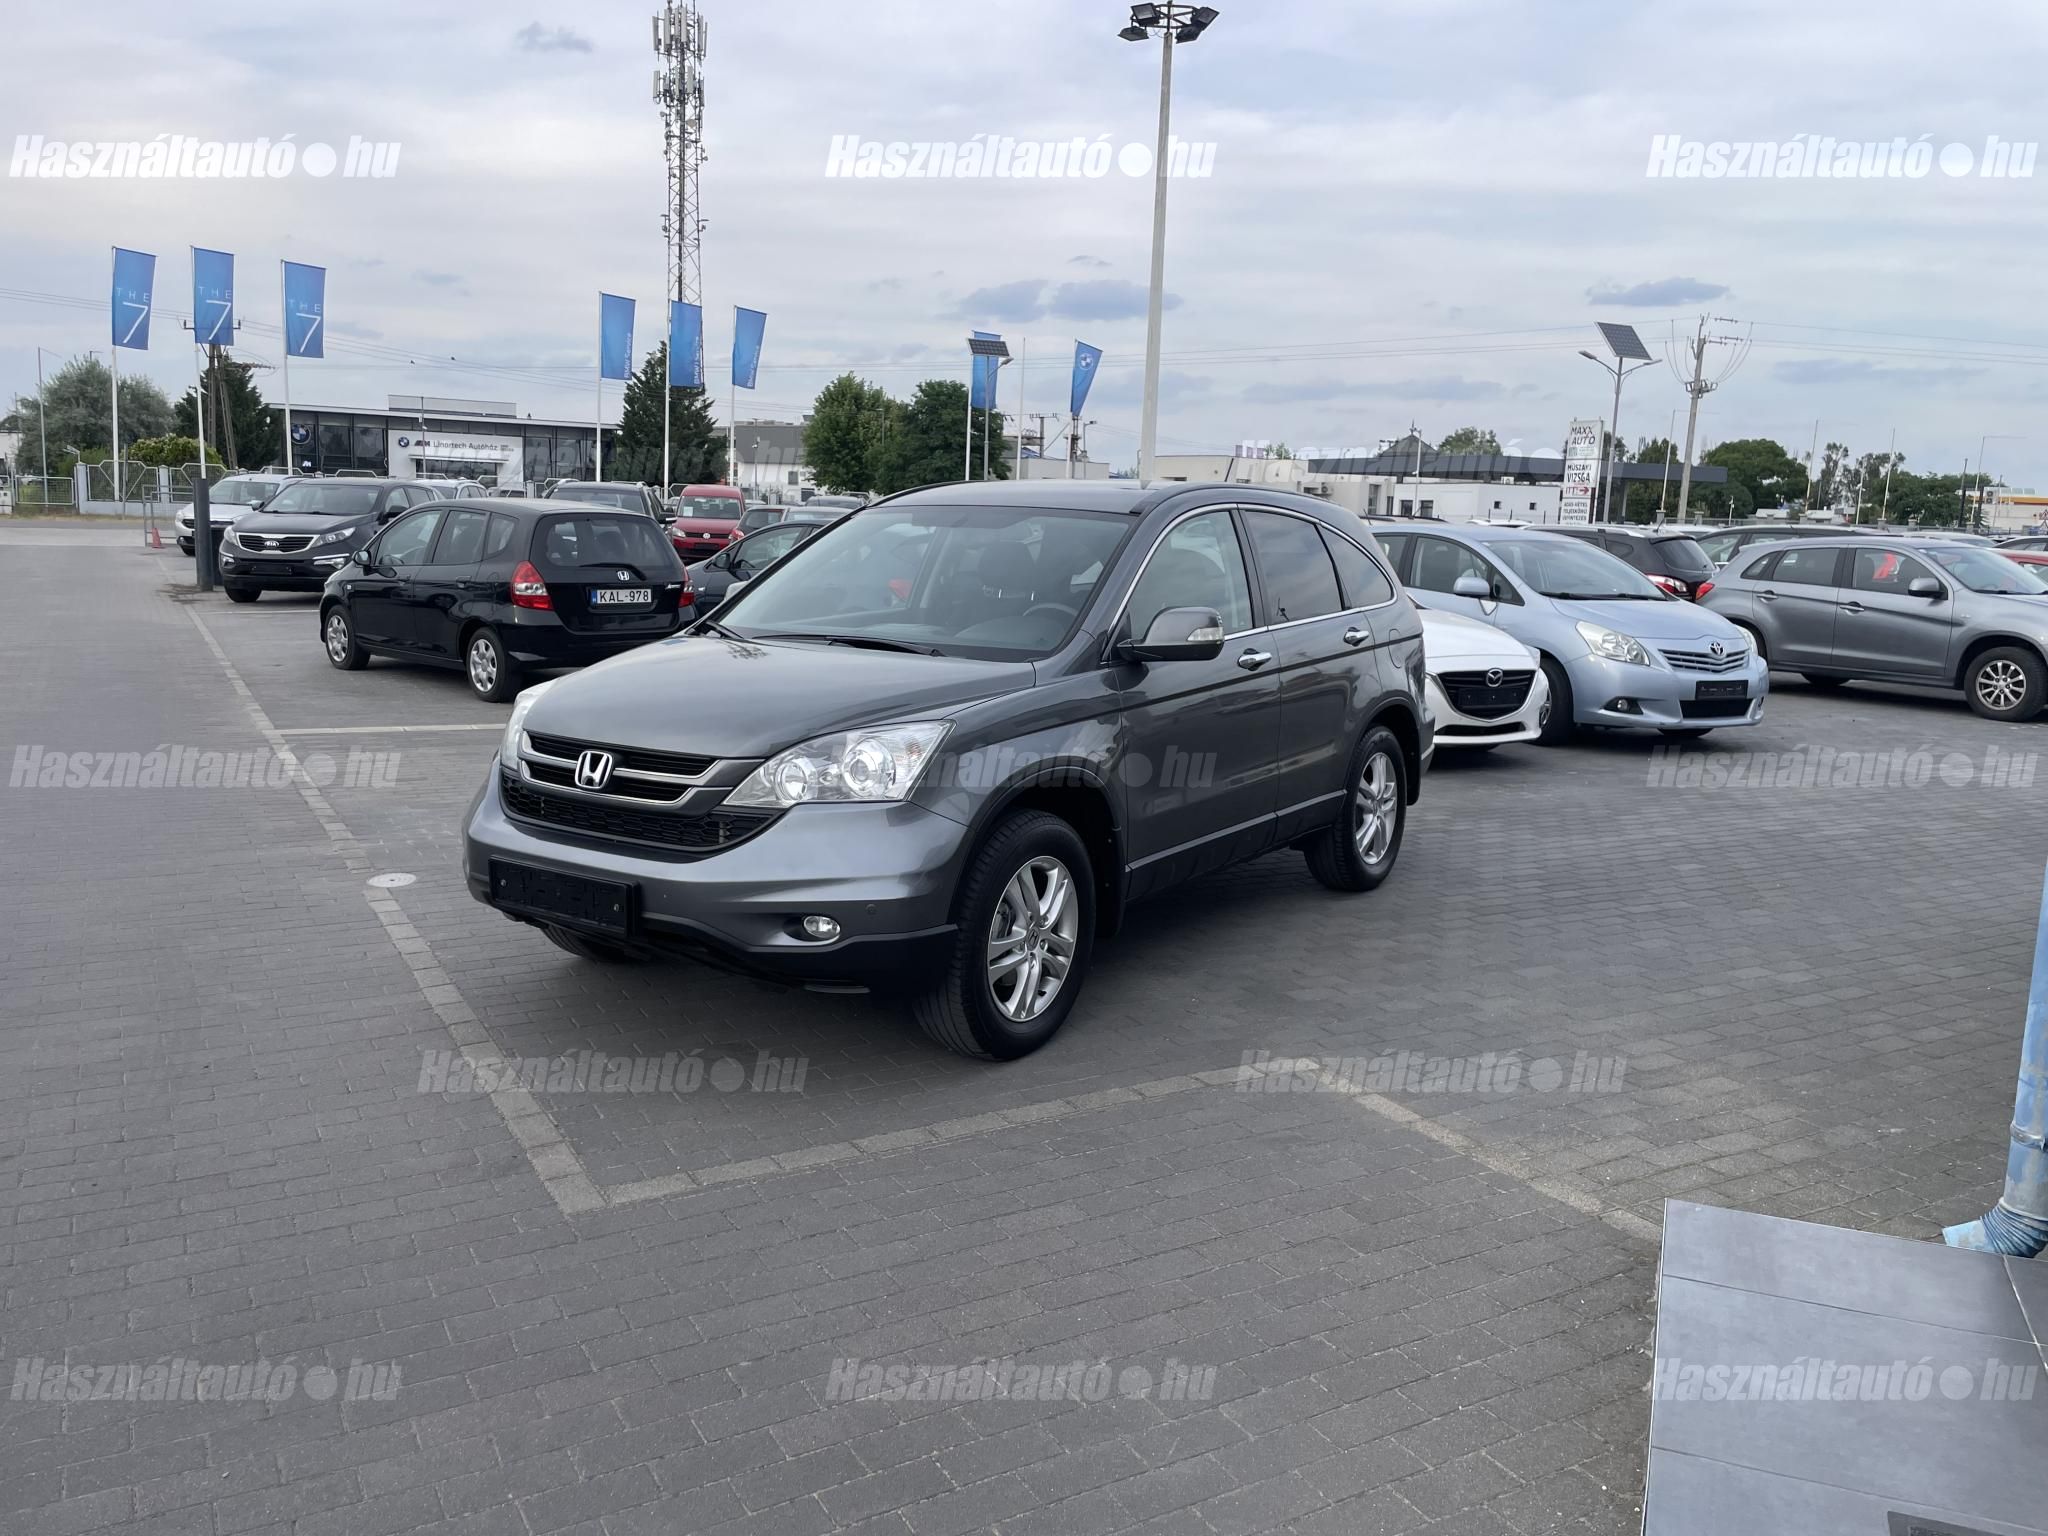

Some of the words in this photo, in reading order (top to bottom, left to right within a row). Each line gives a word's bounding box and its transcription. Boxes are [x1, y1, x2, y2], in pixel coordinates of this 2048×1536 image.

[116, 287, 150, 303] THE
[198, 287, 232, 299] THE
[287, 299, 321, 314] THE
[122, 301, 149, 344] 7
[206, 299, 231, 341] 7
[296, 312, 321, 353] 7
[1570, 426, 1593, 435] MAXX
[469, 442, 498, 451] Autóház
[1571, 435, 1595, 446] AUTO
[1567, 472, 1590, 483] VIZSGA
[600, 590, 649, 602] KAL-978
